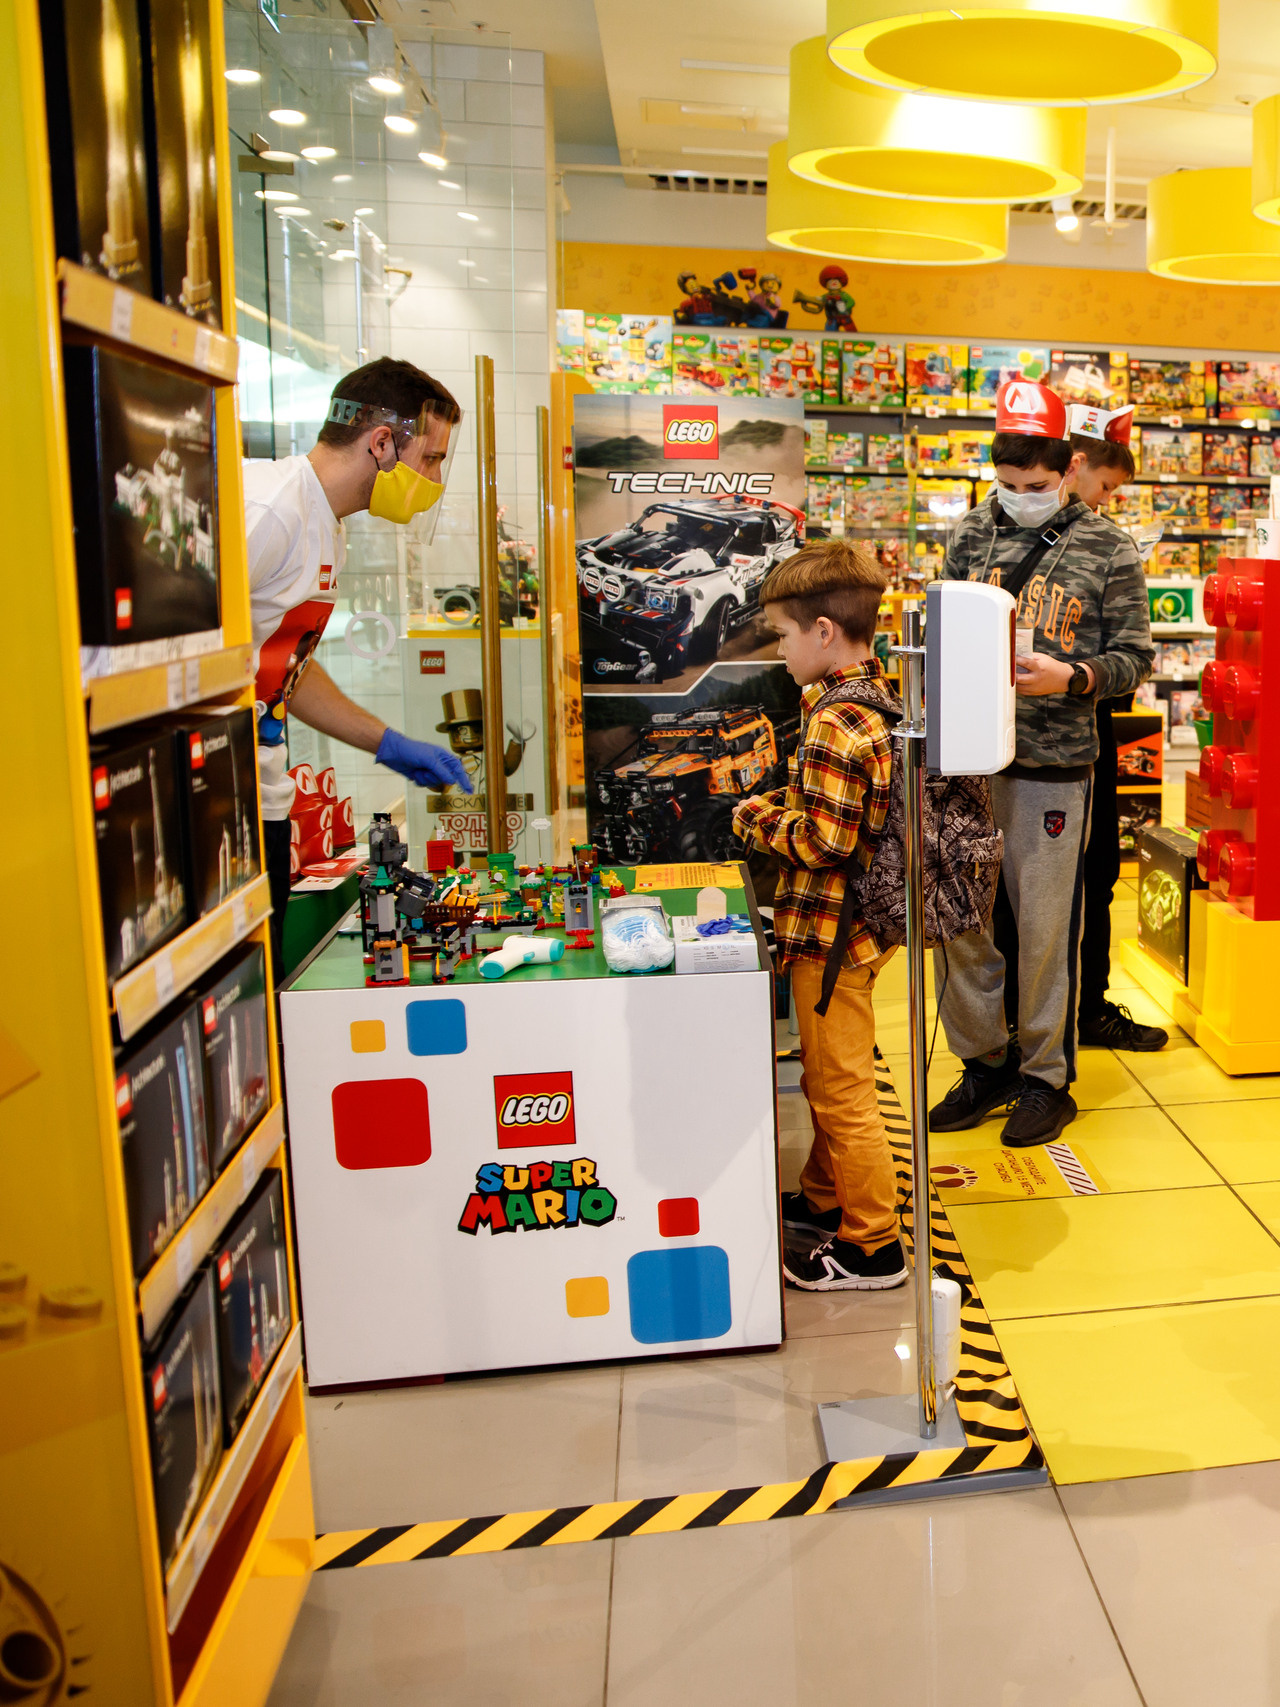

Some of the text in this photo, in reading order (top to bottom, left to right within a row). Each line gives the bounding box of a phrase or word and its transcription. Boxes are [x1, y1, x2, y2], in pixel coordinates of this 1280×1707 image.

[665, 419, 716, 444] LEGO
[607, 472, 774, 494] TECHNIC
[422, 657, 443, 667] LEGO
[501, 1093, 571, 1127] LEGO
[476, 1157, 599, 1193] SUPER
[458, 1187, 617, 1236] MARIO
